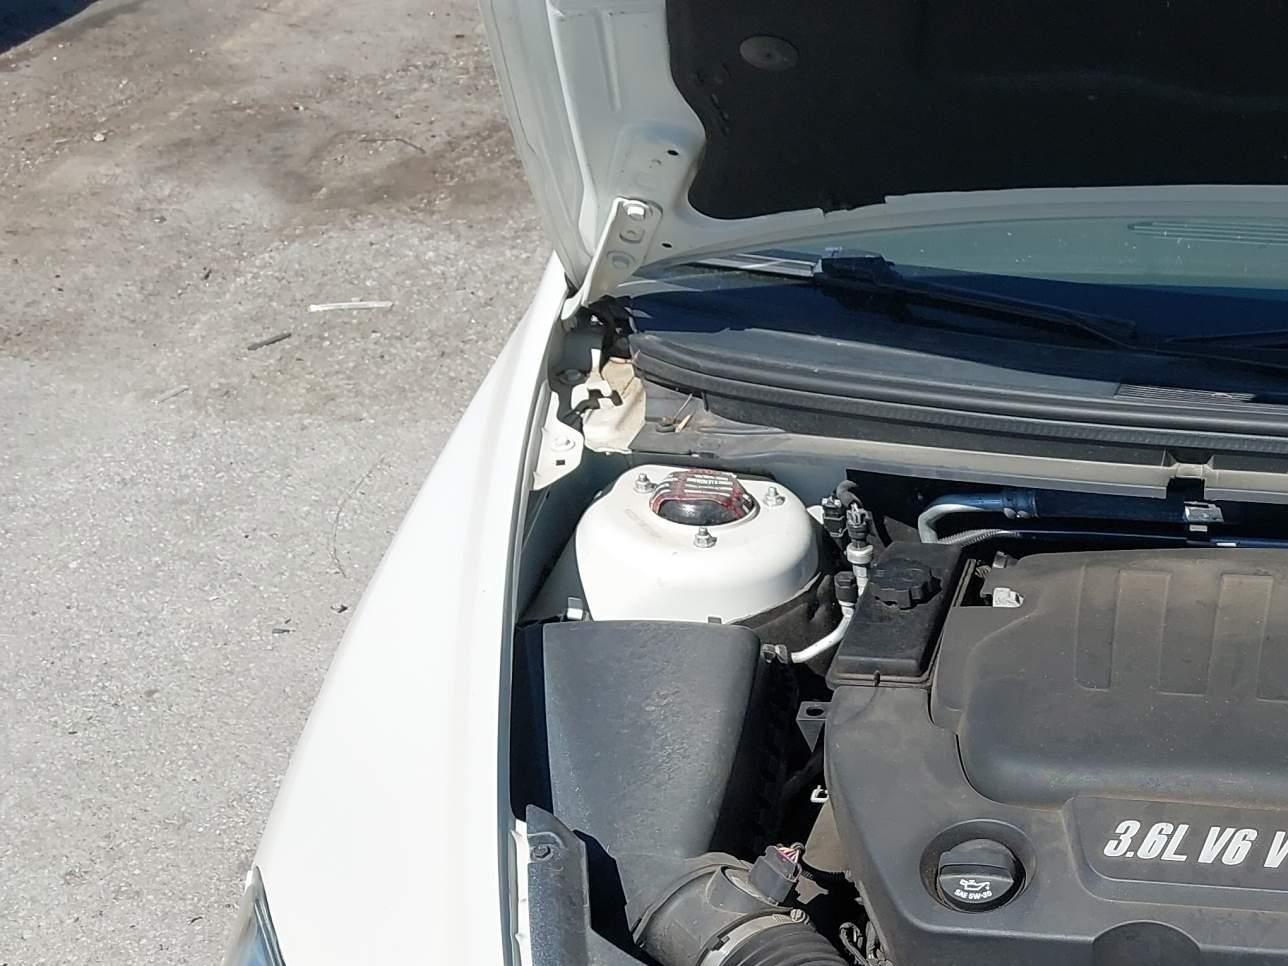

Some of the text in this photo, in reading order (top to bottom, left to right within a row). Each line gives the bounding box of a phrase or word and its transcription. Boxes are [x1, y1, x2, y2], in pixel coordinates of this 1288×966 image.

[1103, 819, 1188, 862] 3.6L
[1198, 826, 1258, 867] V6
[954, 888, 968, 899] SAE
